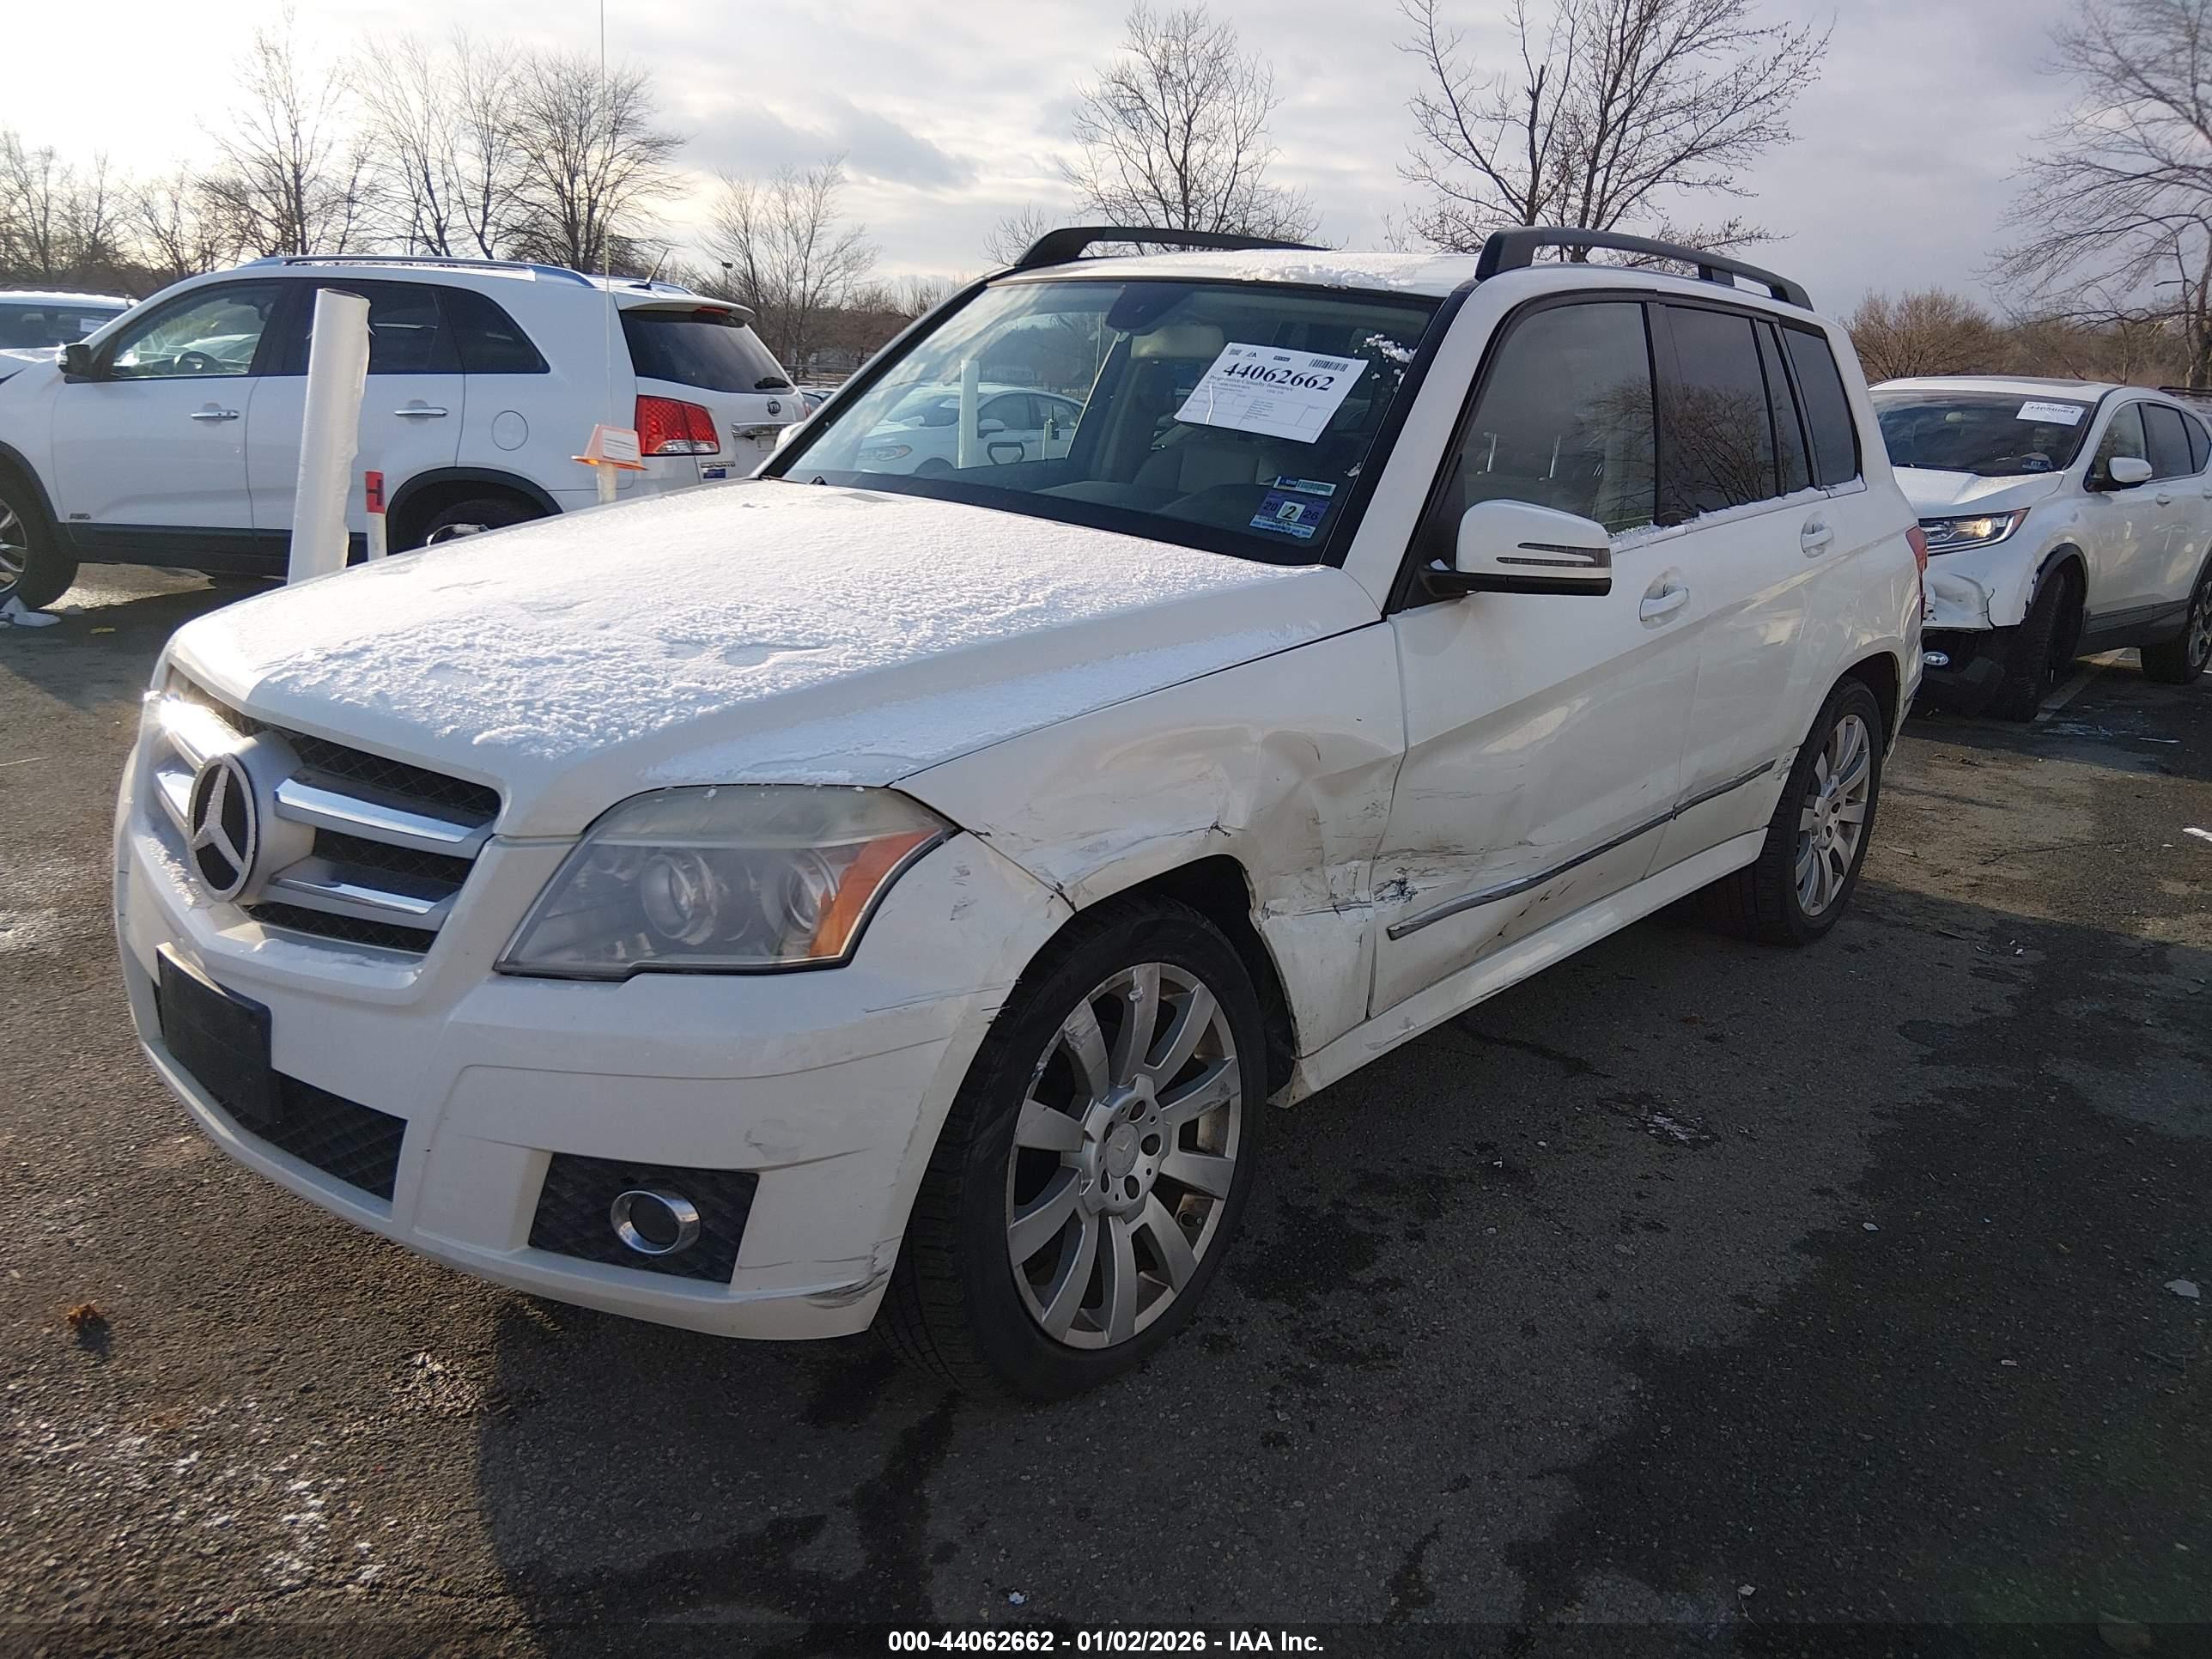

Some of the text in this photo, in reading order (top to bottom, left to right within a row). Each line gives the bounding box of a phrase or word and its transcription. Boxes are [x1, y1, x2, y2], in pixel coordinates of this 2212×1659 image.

[1223, 362, 1335, 392] 44062662
[1263, 501, 1319, 520] 20 2 26
